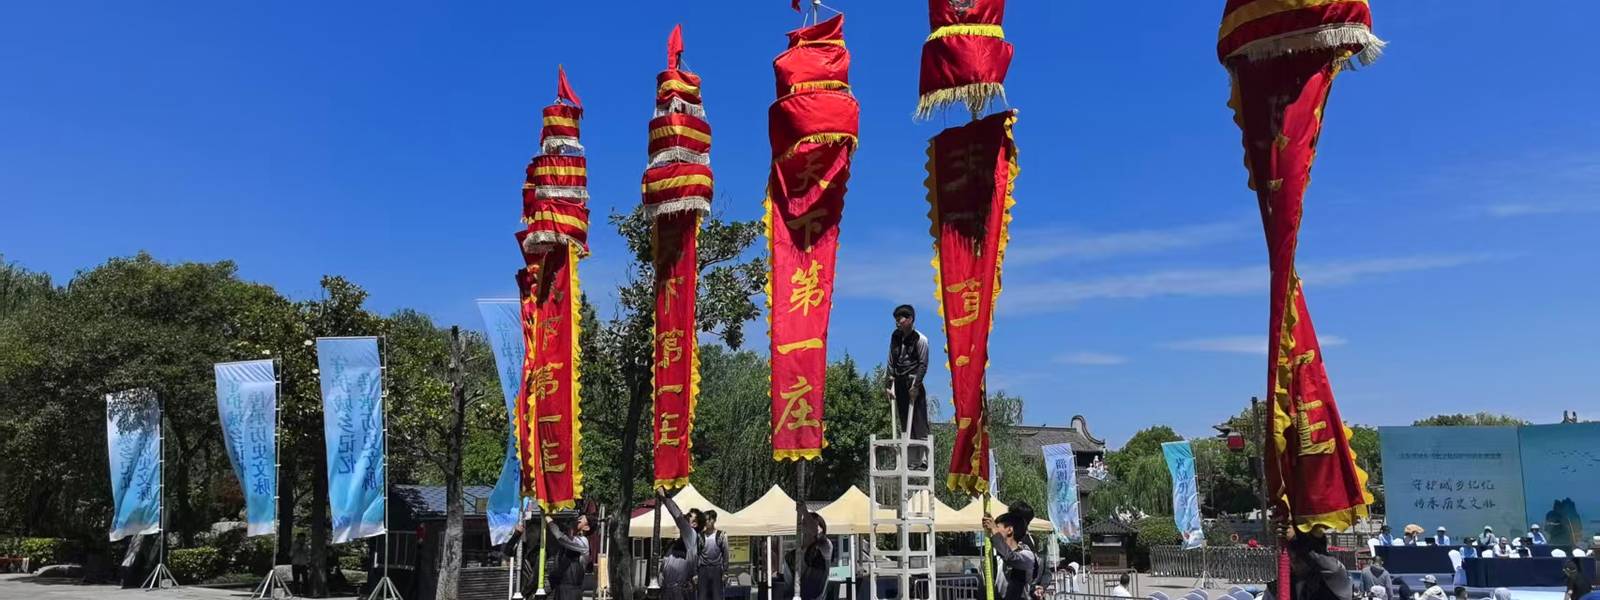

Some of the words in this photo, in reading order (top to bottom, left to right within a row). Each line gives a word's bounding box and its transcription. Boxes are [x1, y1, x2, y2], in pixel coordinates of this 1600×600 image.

[775, 153, 837, 434] 天下第一庄
